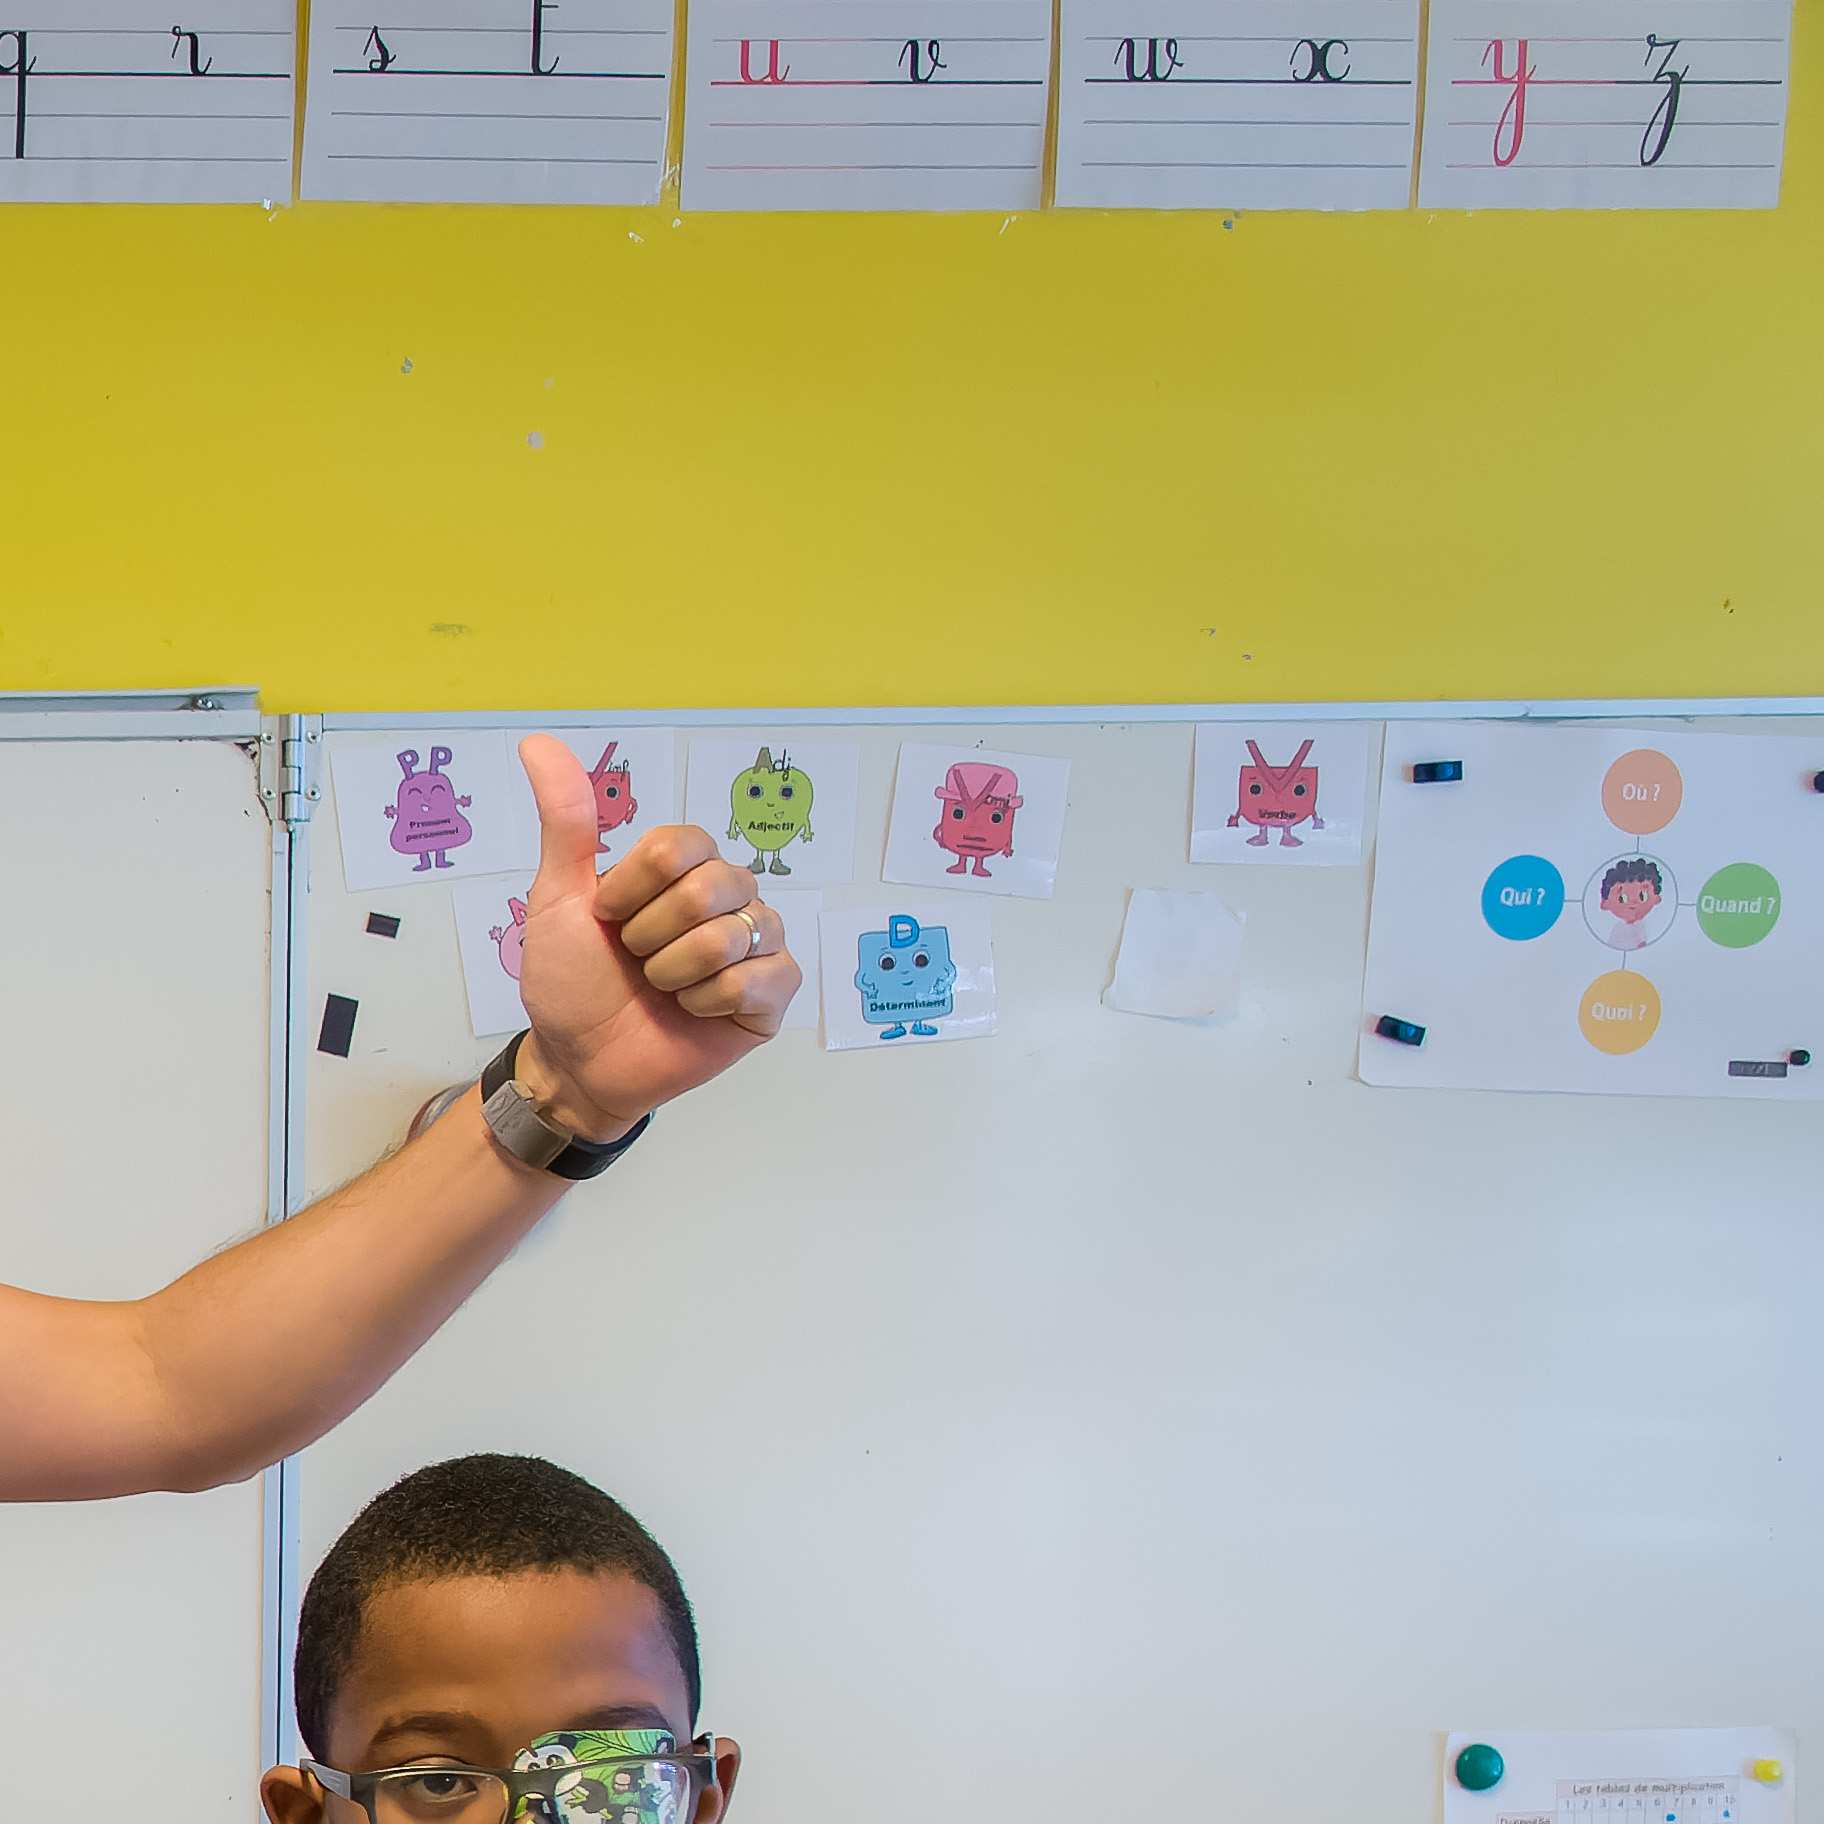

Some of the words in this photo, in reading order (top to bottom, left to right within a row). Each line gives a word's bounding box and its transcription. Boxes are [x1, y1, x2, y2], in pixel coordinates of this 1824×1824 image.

[171, 26, 212, 76] r
[362, 25, 396, 73] s
[739, 38, 789, 83] u
[899, 38, 947, 83] v
[1114, 36, 1181, 83] w
[1290, 38, 1350, 83] x
[1482, 36, 1538, 167] y
[1645, 33, 1689, 167] z
[1622, 782, 1648, 801] Où
[1500, 886, 1532, 906] Qui
[1536, 887, 1546, 905] ?
[1701, 895, 1761, 914] Quand
[1767, 897, 1776, 915] ?
[1591, 1002, 1633, 1021] Quoi
[1638, 1004, 1647, 1021] ?
